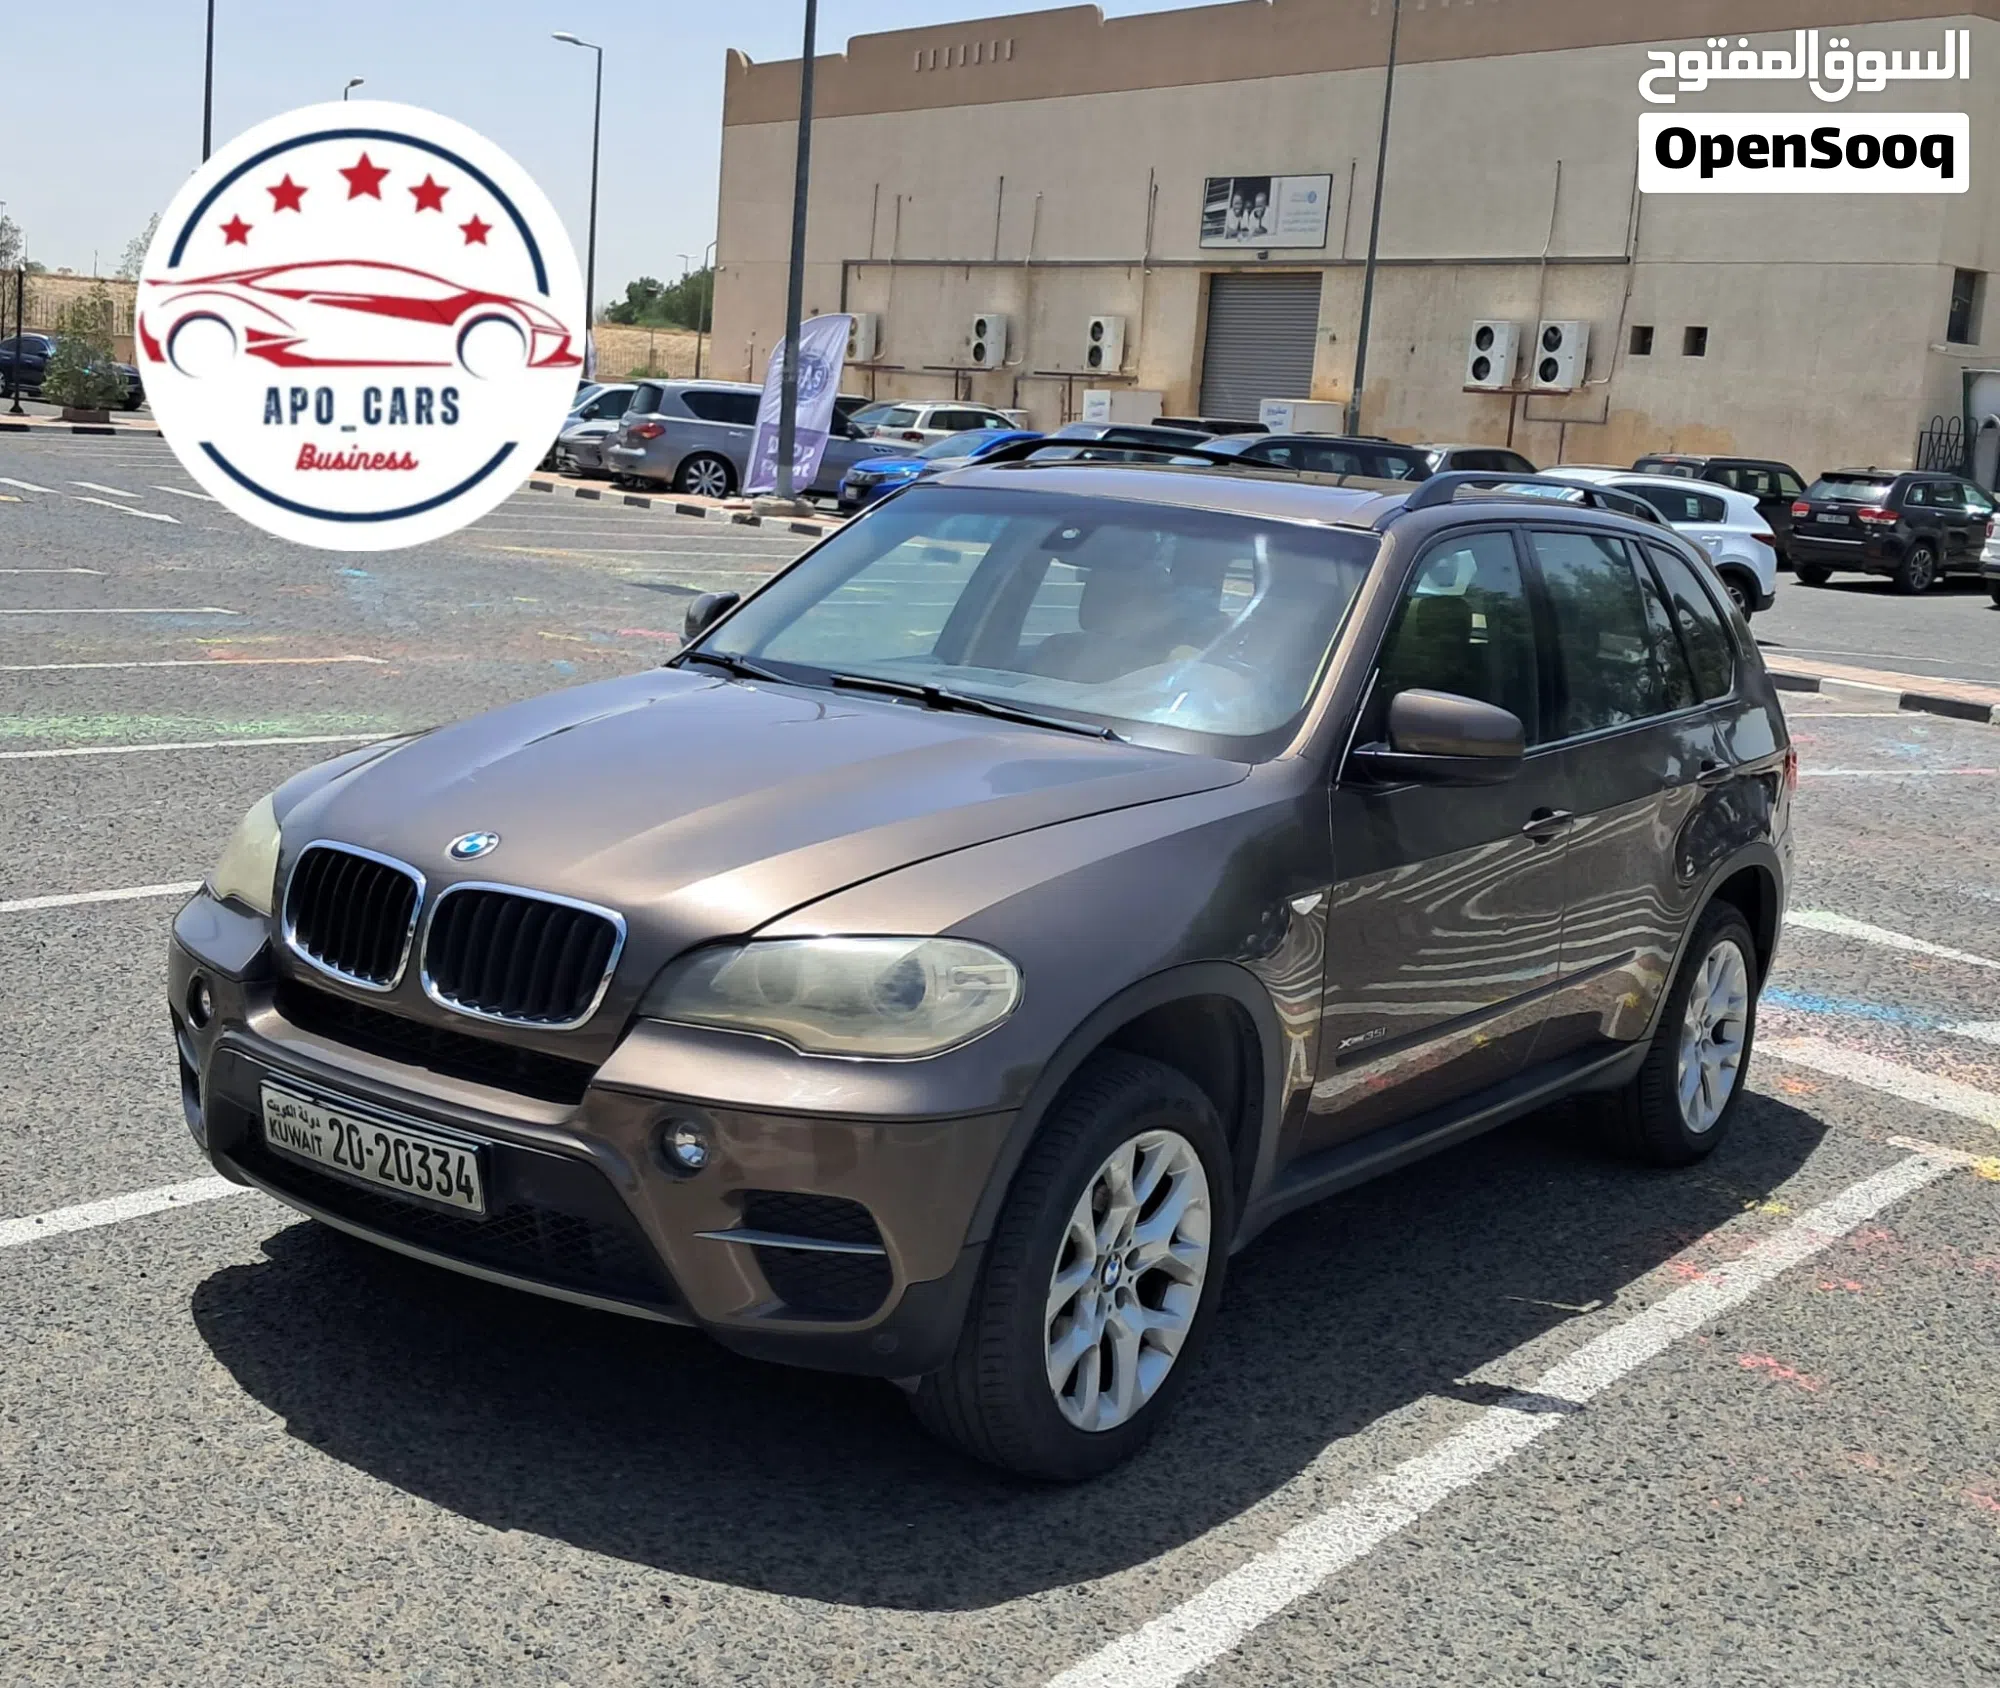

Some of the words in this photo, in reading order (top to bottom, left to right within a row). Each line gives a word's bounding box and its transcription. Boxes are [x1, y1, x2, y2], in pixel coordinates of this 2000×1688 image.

[767, 434, 815, 463] Dop
[266, 1098, 297, 1118] الكويت
[298, 1105, 321, 1129] دولة
[269, 1116, 323, 1157] KUWAIT
[328, 1117, 474, 1204] 20-20334
